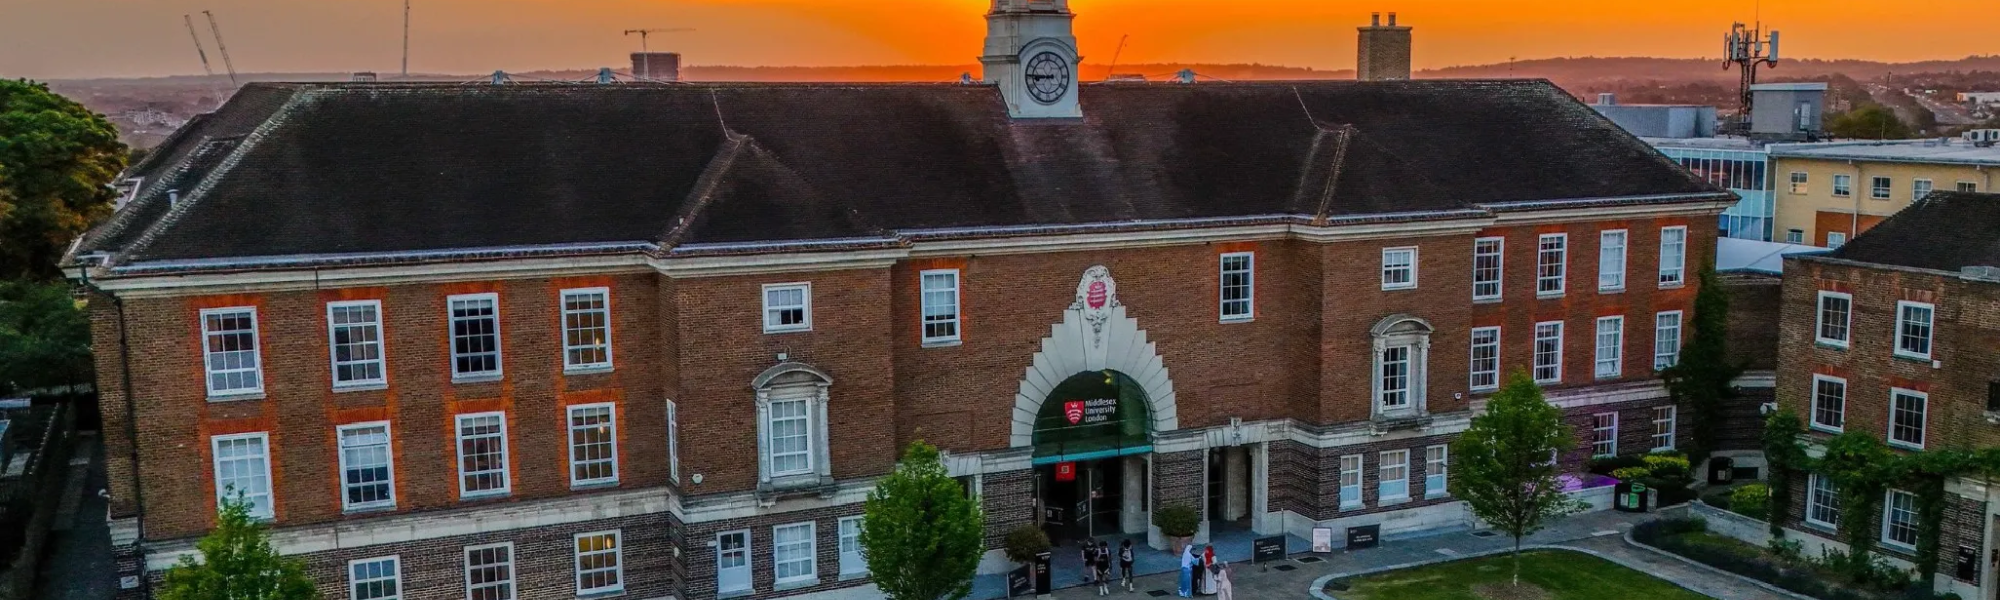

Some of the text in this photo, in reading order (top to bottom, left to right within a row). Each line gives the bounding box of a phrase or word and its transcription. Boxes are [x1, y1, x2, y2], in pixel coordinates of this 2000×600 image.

[1085, 398, 1116, 406] Middlesex
[1085, 405, 1116, 414] University
[1085, 414, 1107, 422] London
